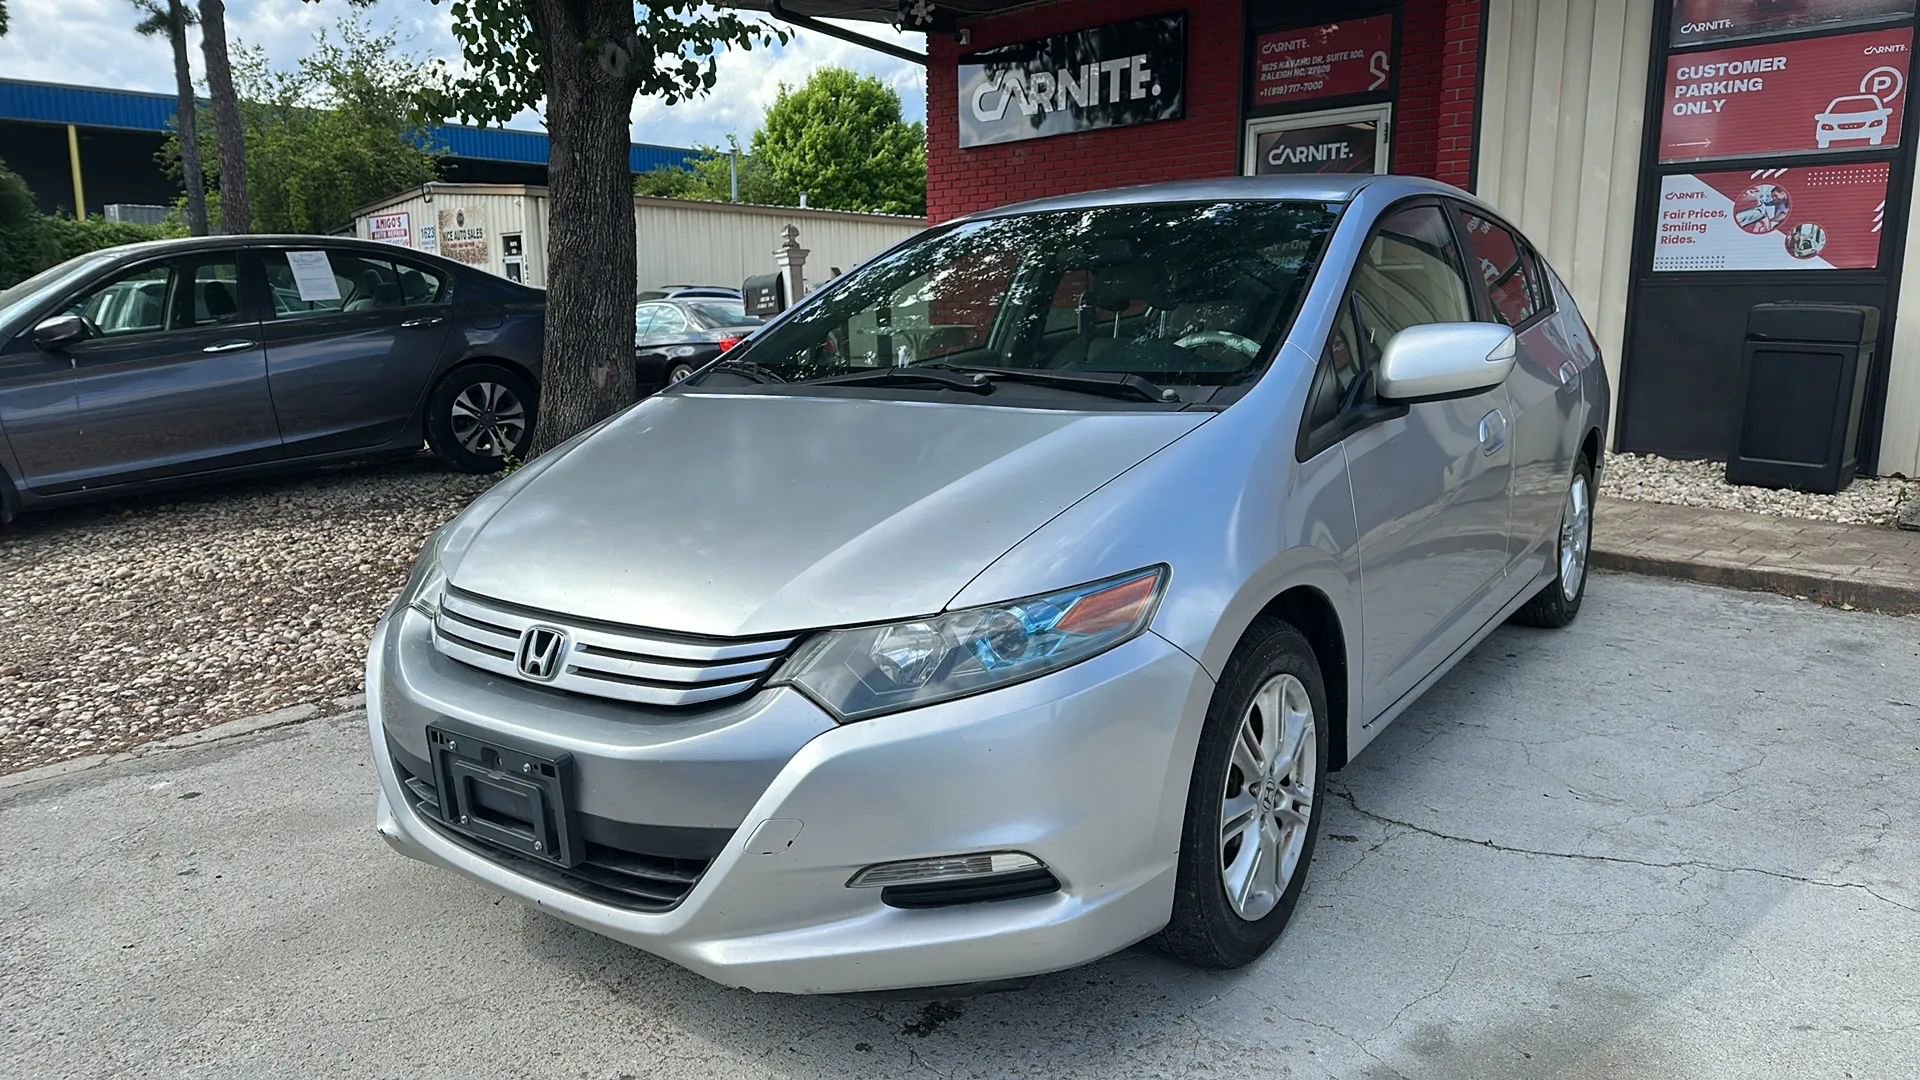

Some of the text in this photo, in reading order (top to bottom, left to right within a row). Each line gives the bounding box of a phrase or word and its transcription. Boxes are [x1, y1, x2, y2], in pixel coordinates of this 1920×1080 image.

[1680, 19, 1734, 34] CARNITE.
[1263, 38, 1310, 54] CARNITE.
[1863, 44, 1908, 55] CARNITE.
[1326, 51, 1349, 62] SUITE
[1676, 56, 1787, 80] CUSTOMER
[1261, 70, 1292, 81] RALEIGH
[973, 54, 1161, 122] CARNITE.
[1288, 80, 1323, 92] 717-7000
[1674, 77, 1764, 98] PARKING
[1873, 76, 1891, 93] P
[1672, 99, 1727, 116] ONLY
[1269, 142, 1353, 165] CARNITE.
[1665, 191, 1707, 200] CARNITE.
[1663, 208, 1728, 219] Fair Prices,
[376, 216, 401, 229] AMIGO'S
[1662, 221, 1707, 233] Smiling
[420, 227, 435, 239] 1623
[454, 230, 467, 240] AUTO
[467, 228, 483, 239] SALES
[1660, 234, 1696, 244] Rides.
